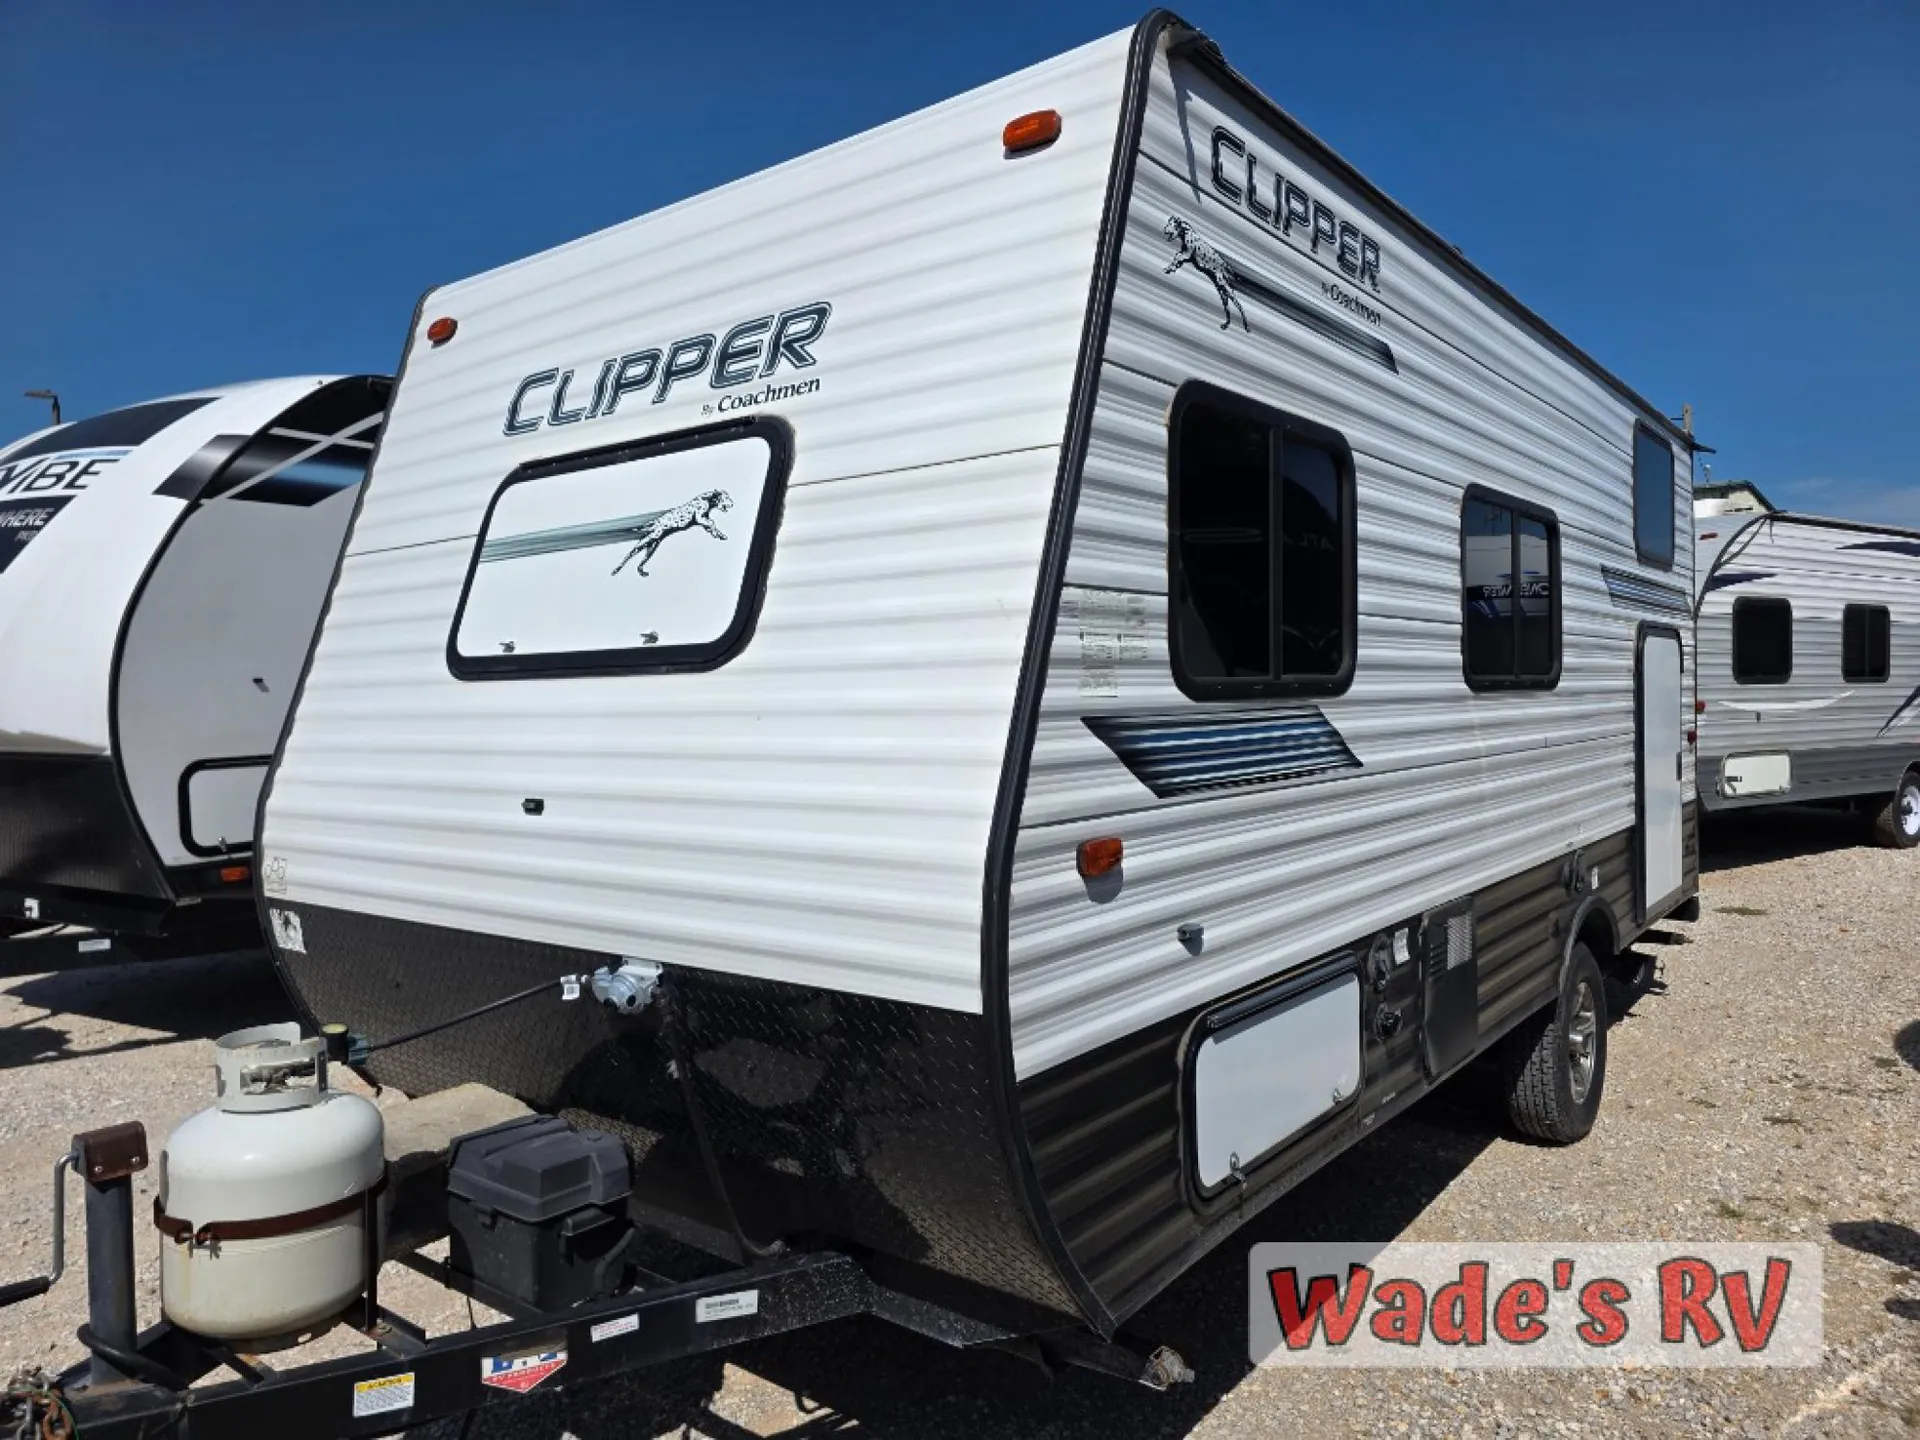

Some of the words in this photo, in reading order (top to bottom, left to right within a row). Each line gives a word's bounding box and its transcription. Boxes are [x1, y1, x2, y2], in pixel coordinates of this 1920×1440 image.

[1211, 125, 1380, 294] CLIPPER
[1330, 284, 1381, 327] Coachmen
[502, 301, 832, 436] CLIPPER
[717, 378, 820, 412] Coachmen
[0, 457, 121, 494] VIBE
